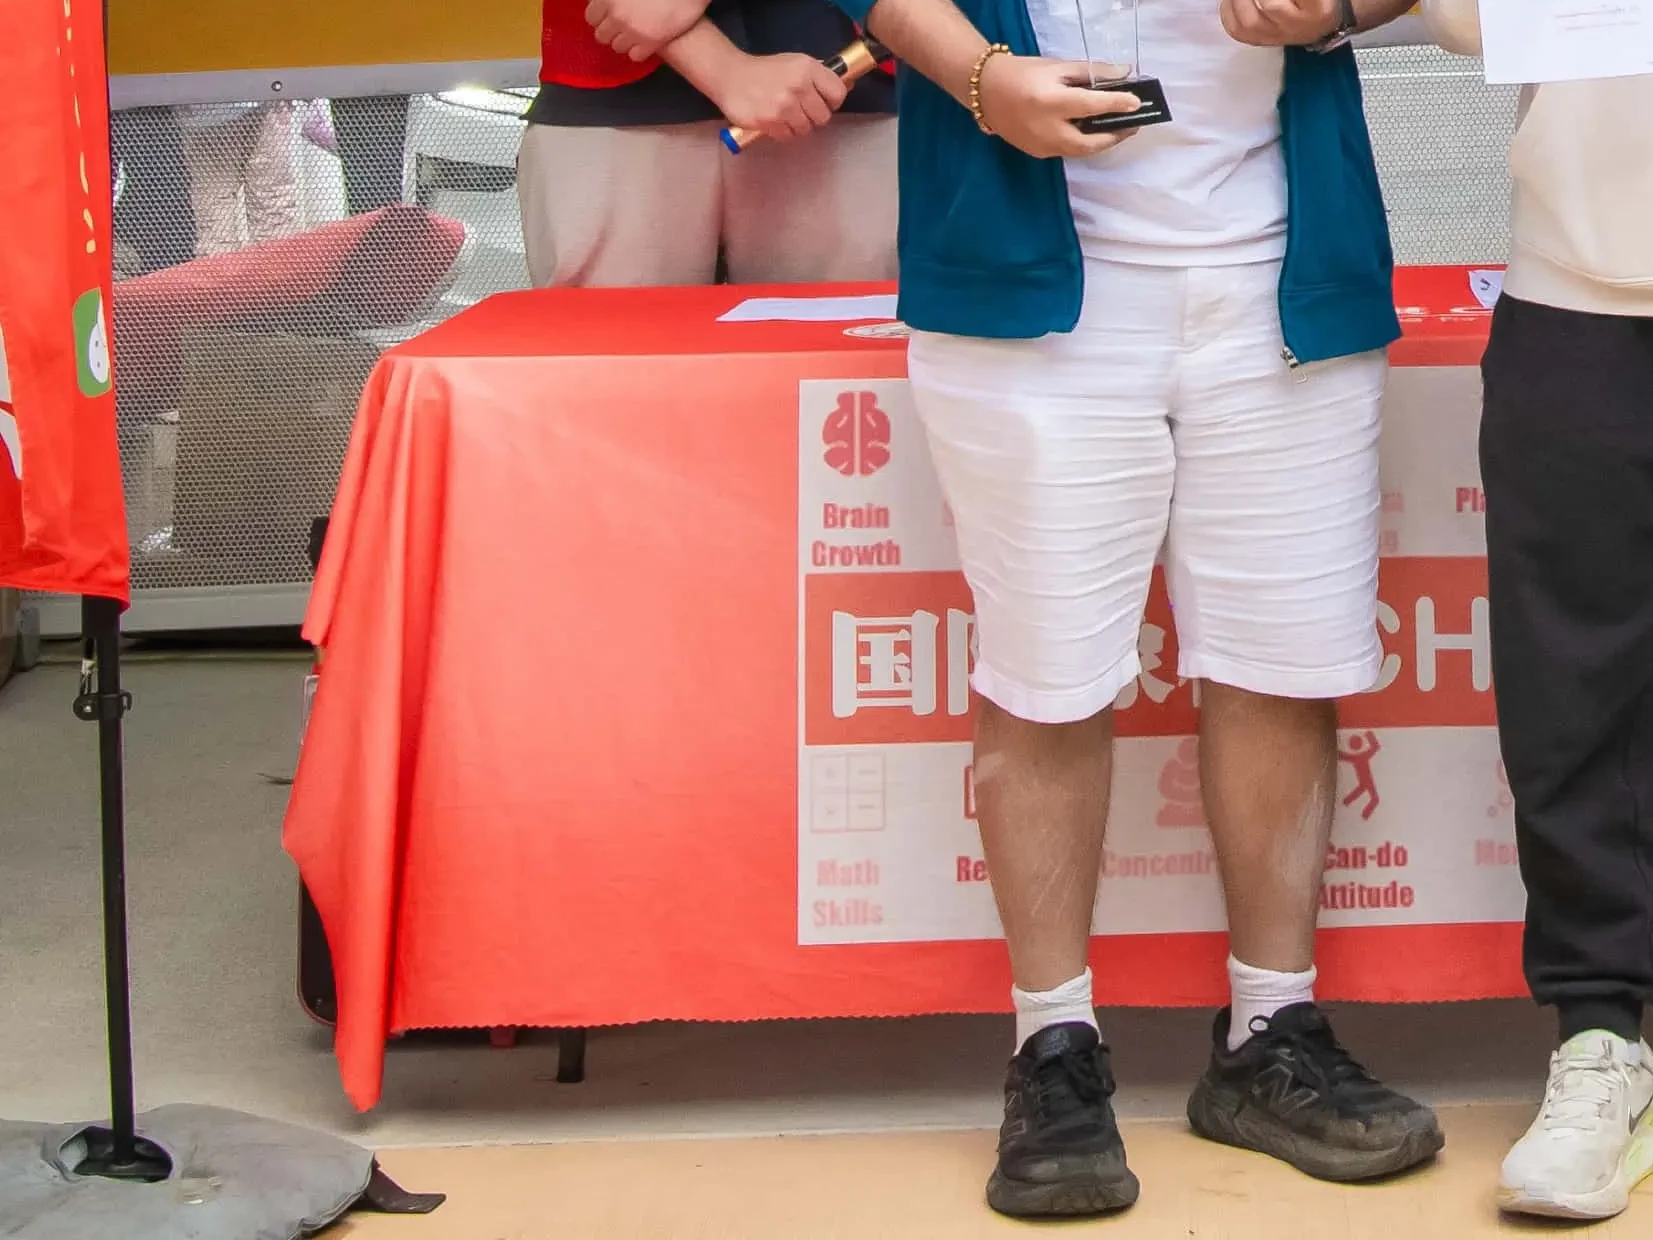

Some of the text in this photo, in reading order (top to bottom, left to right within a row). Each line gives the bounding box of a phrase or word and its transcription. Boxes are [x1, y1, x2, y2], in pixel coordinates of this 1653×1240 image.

[823, 502, 889, 529] Brain
[812, 539, 901, 567] Growth
[813, 899, 884, 926] Skills
